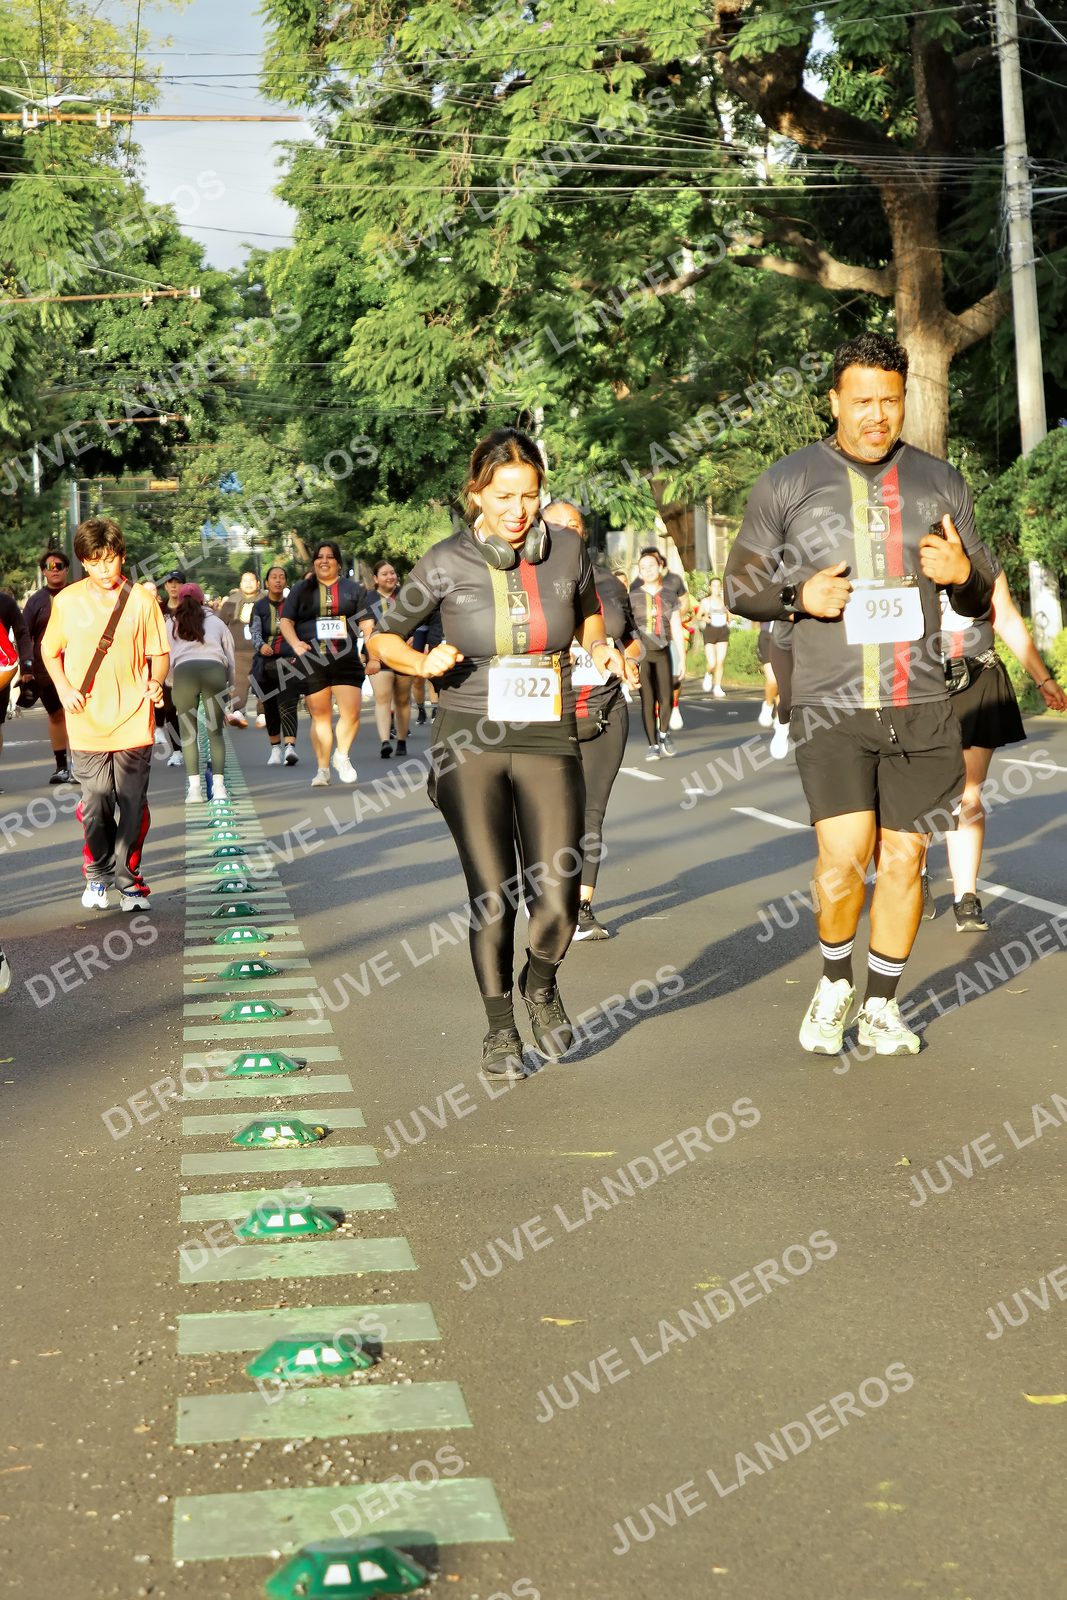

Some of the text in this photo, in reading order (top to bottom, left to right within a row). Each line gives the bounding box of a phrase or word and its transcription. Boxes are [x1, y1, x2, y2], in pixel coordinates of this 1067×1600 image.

[865, 598, 903, 619] 995
[321, 623, 341, 631] 2176
[502, 677, 551, 698] 7822
